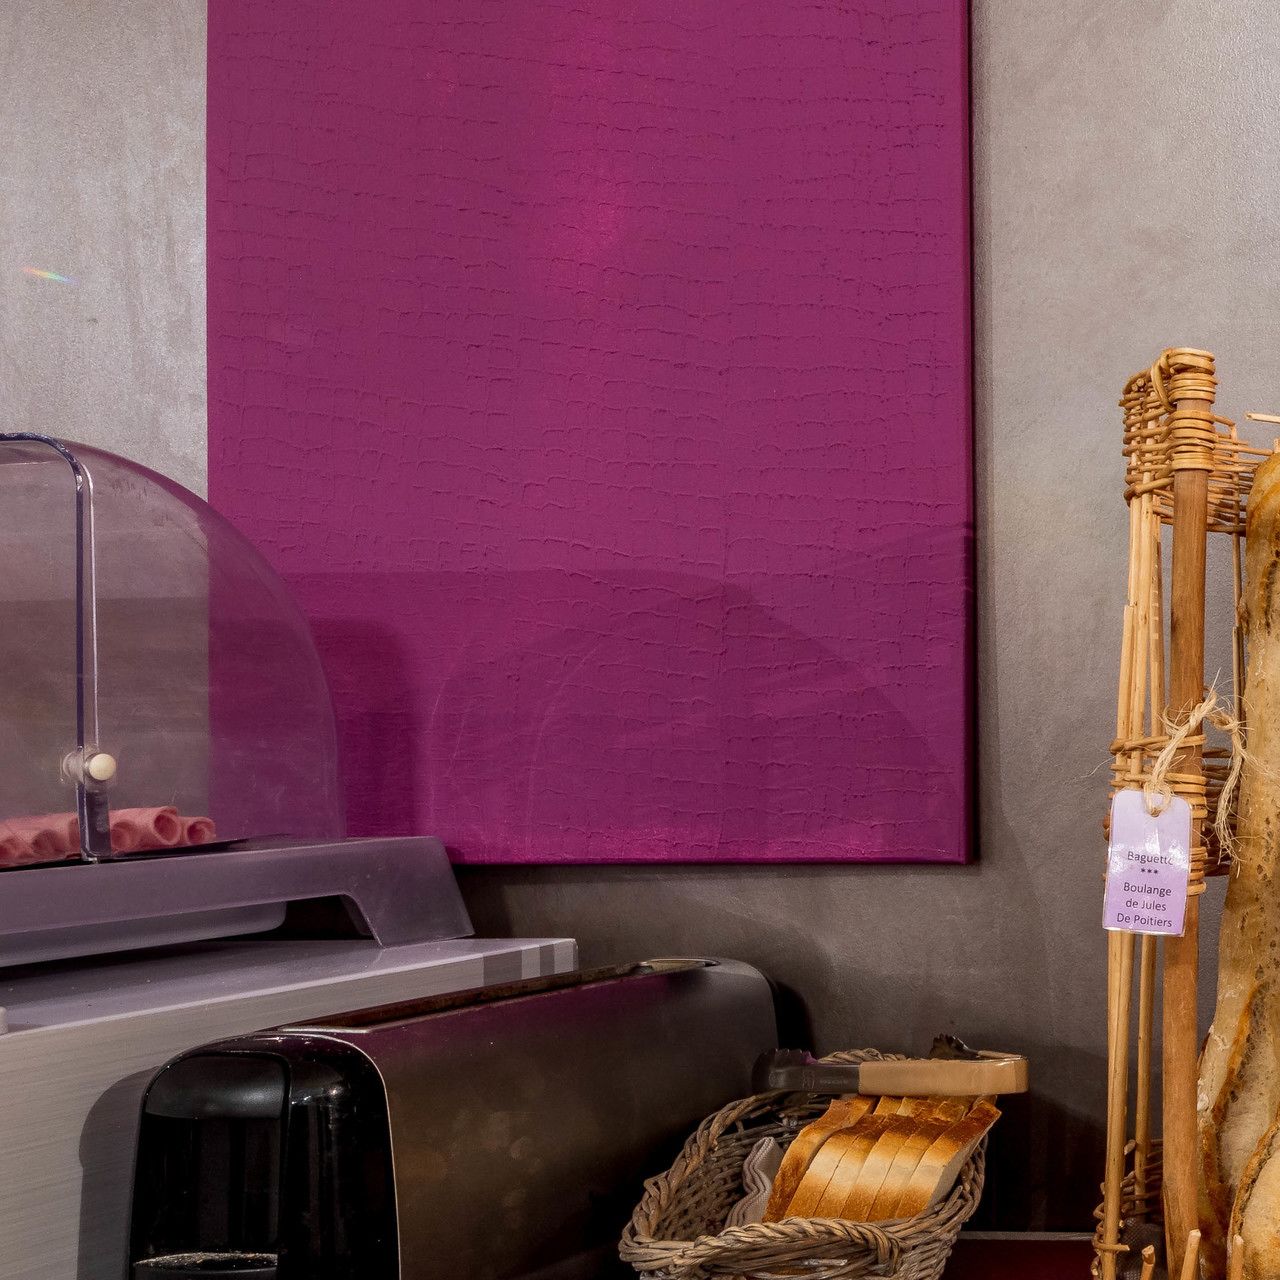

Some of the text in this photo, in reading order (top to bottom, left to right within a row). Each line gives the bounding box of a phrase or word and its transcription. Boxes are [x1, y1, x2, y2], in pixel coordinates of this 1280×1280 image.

[1123, 882, 1172, 897] Boulange
[1125, 898, 1167, 912] de Jules
[1116, 912, 1173, 928] De Poitiers
